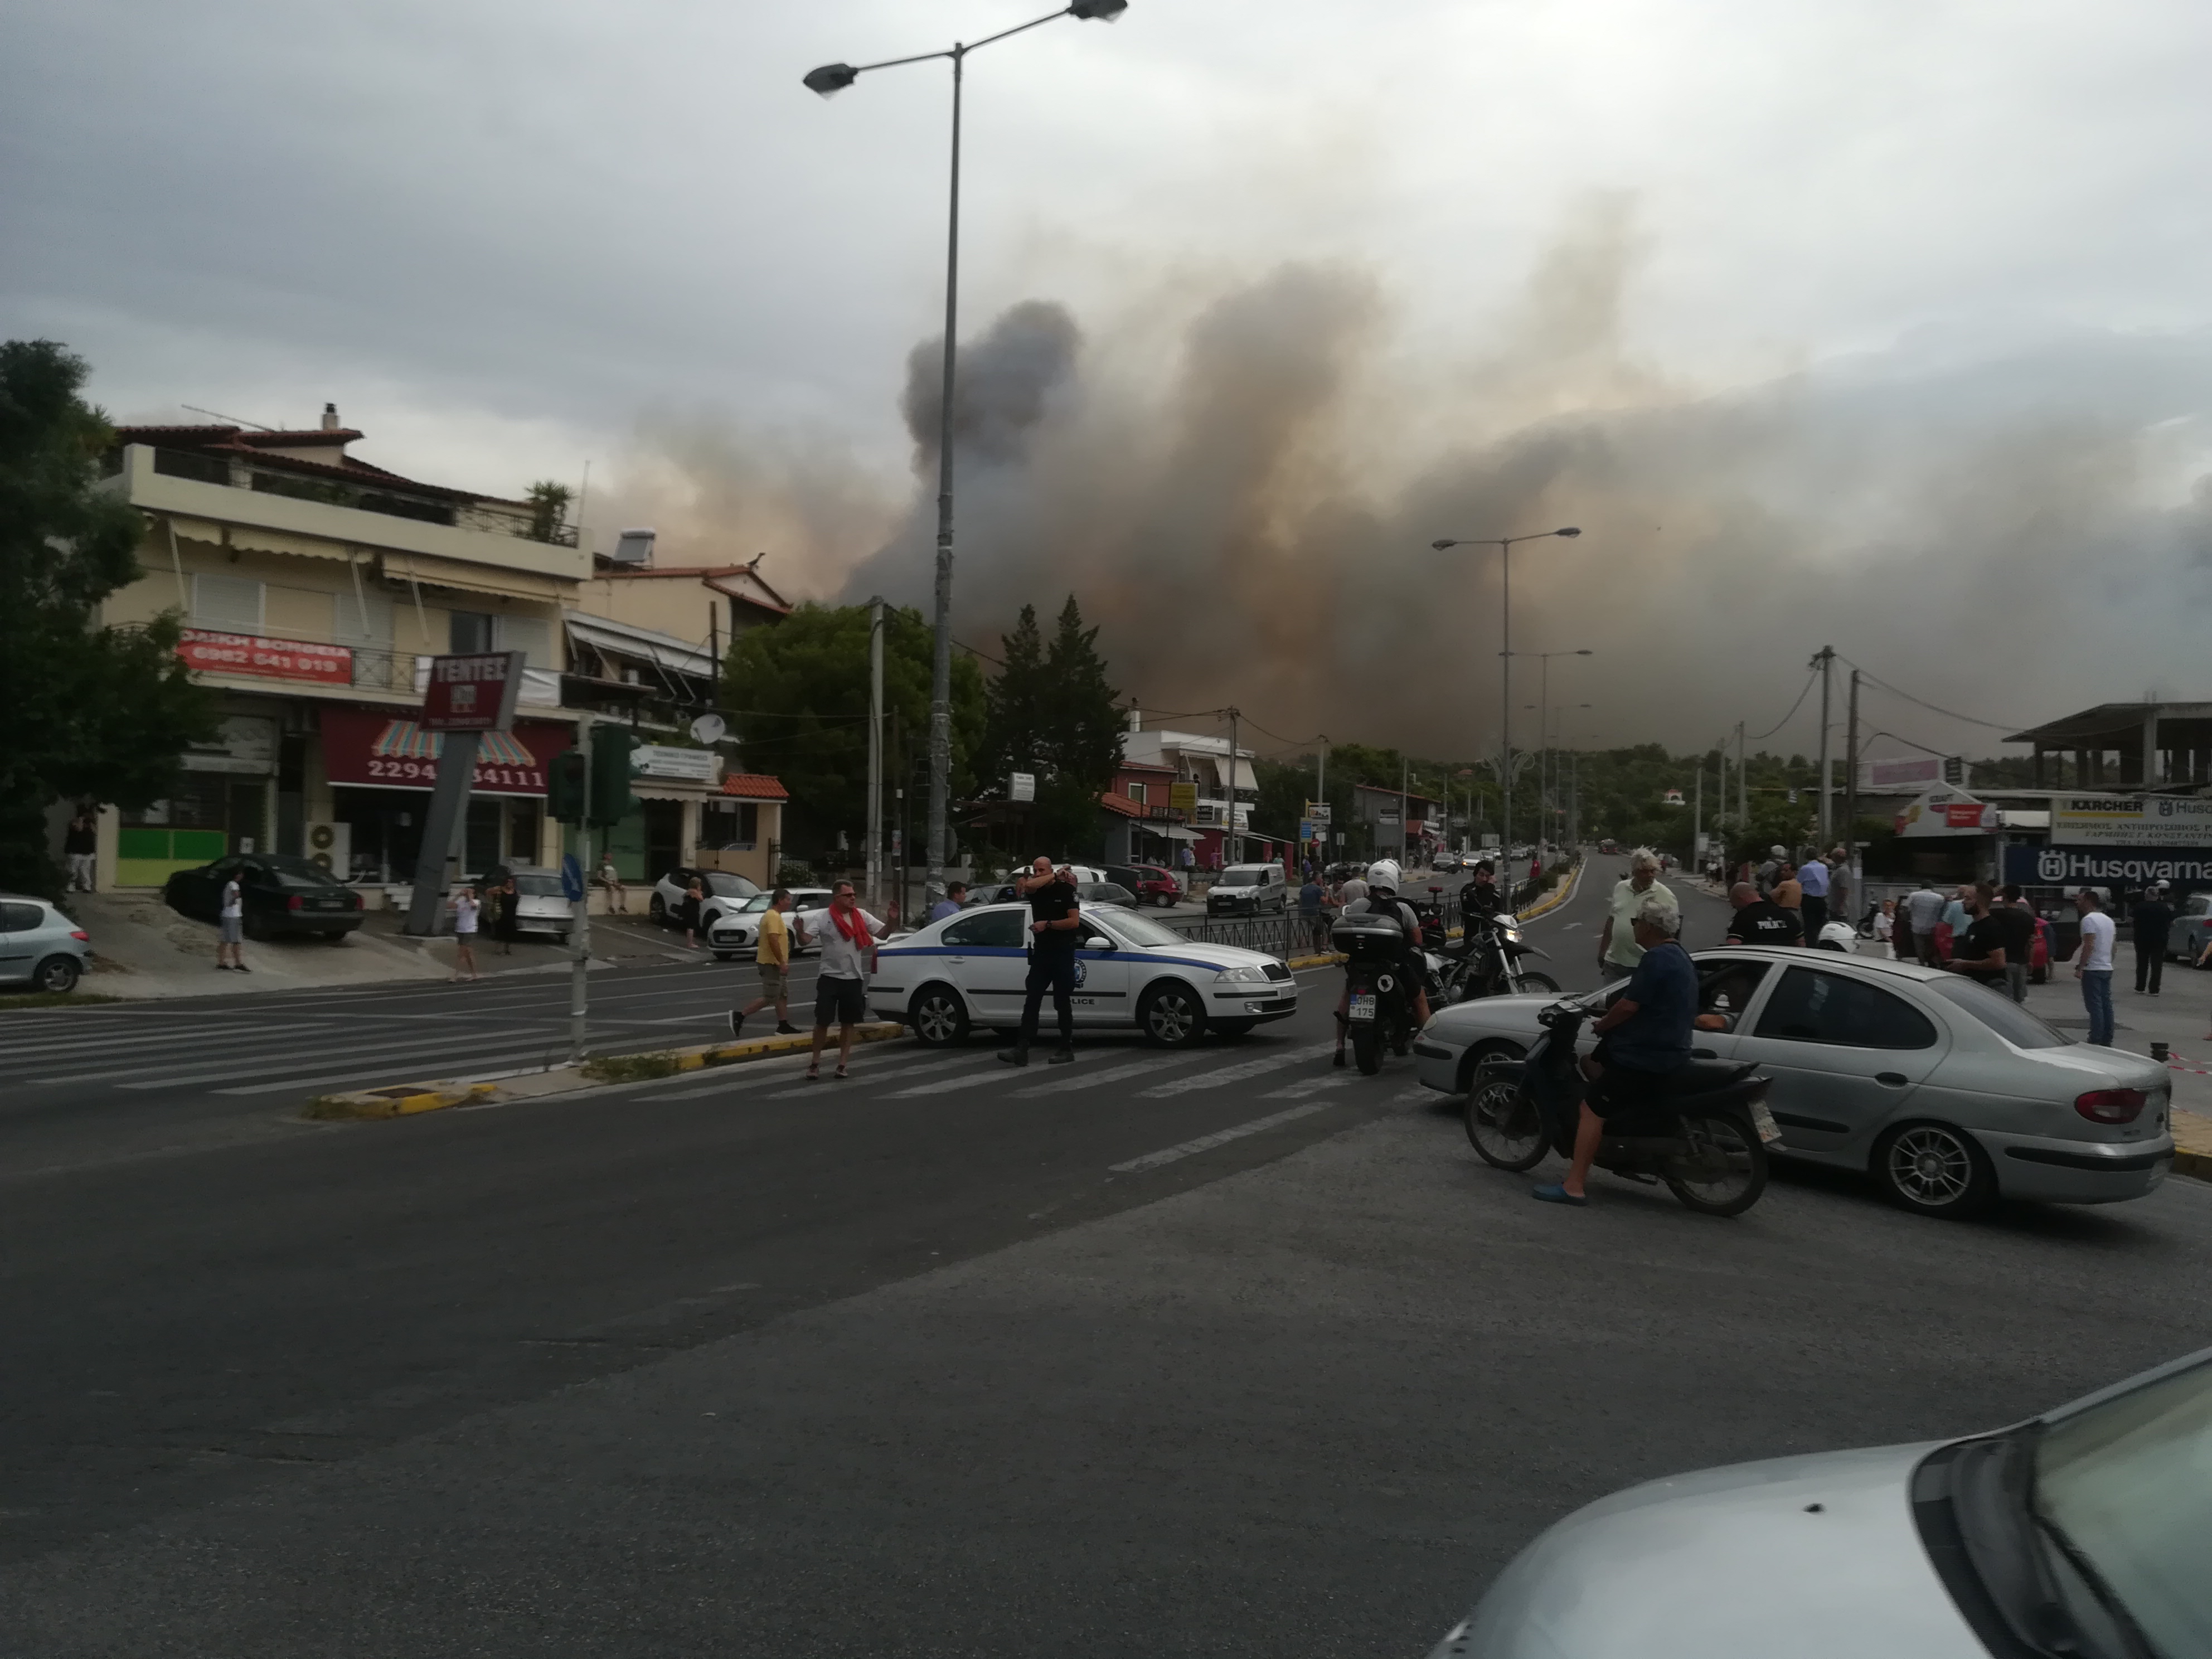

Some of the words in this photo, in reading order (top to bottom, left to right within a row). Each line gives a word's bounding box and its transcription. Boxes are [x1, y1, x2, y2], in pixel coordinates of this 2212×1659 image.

[367, 760, 438, 780] 2294
[2070, 855, 2212, 882] Husqvarna
[1357, 1008, 1374, 1016] 175
